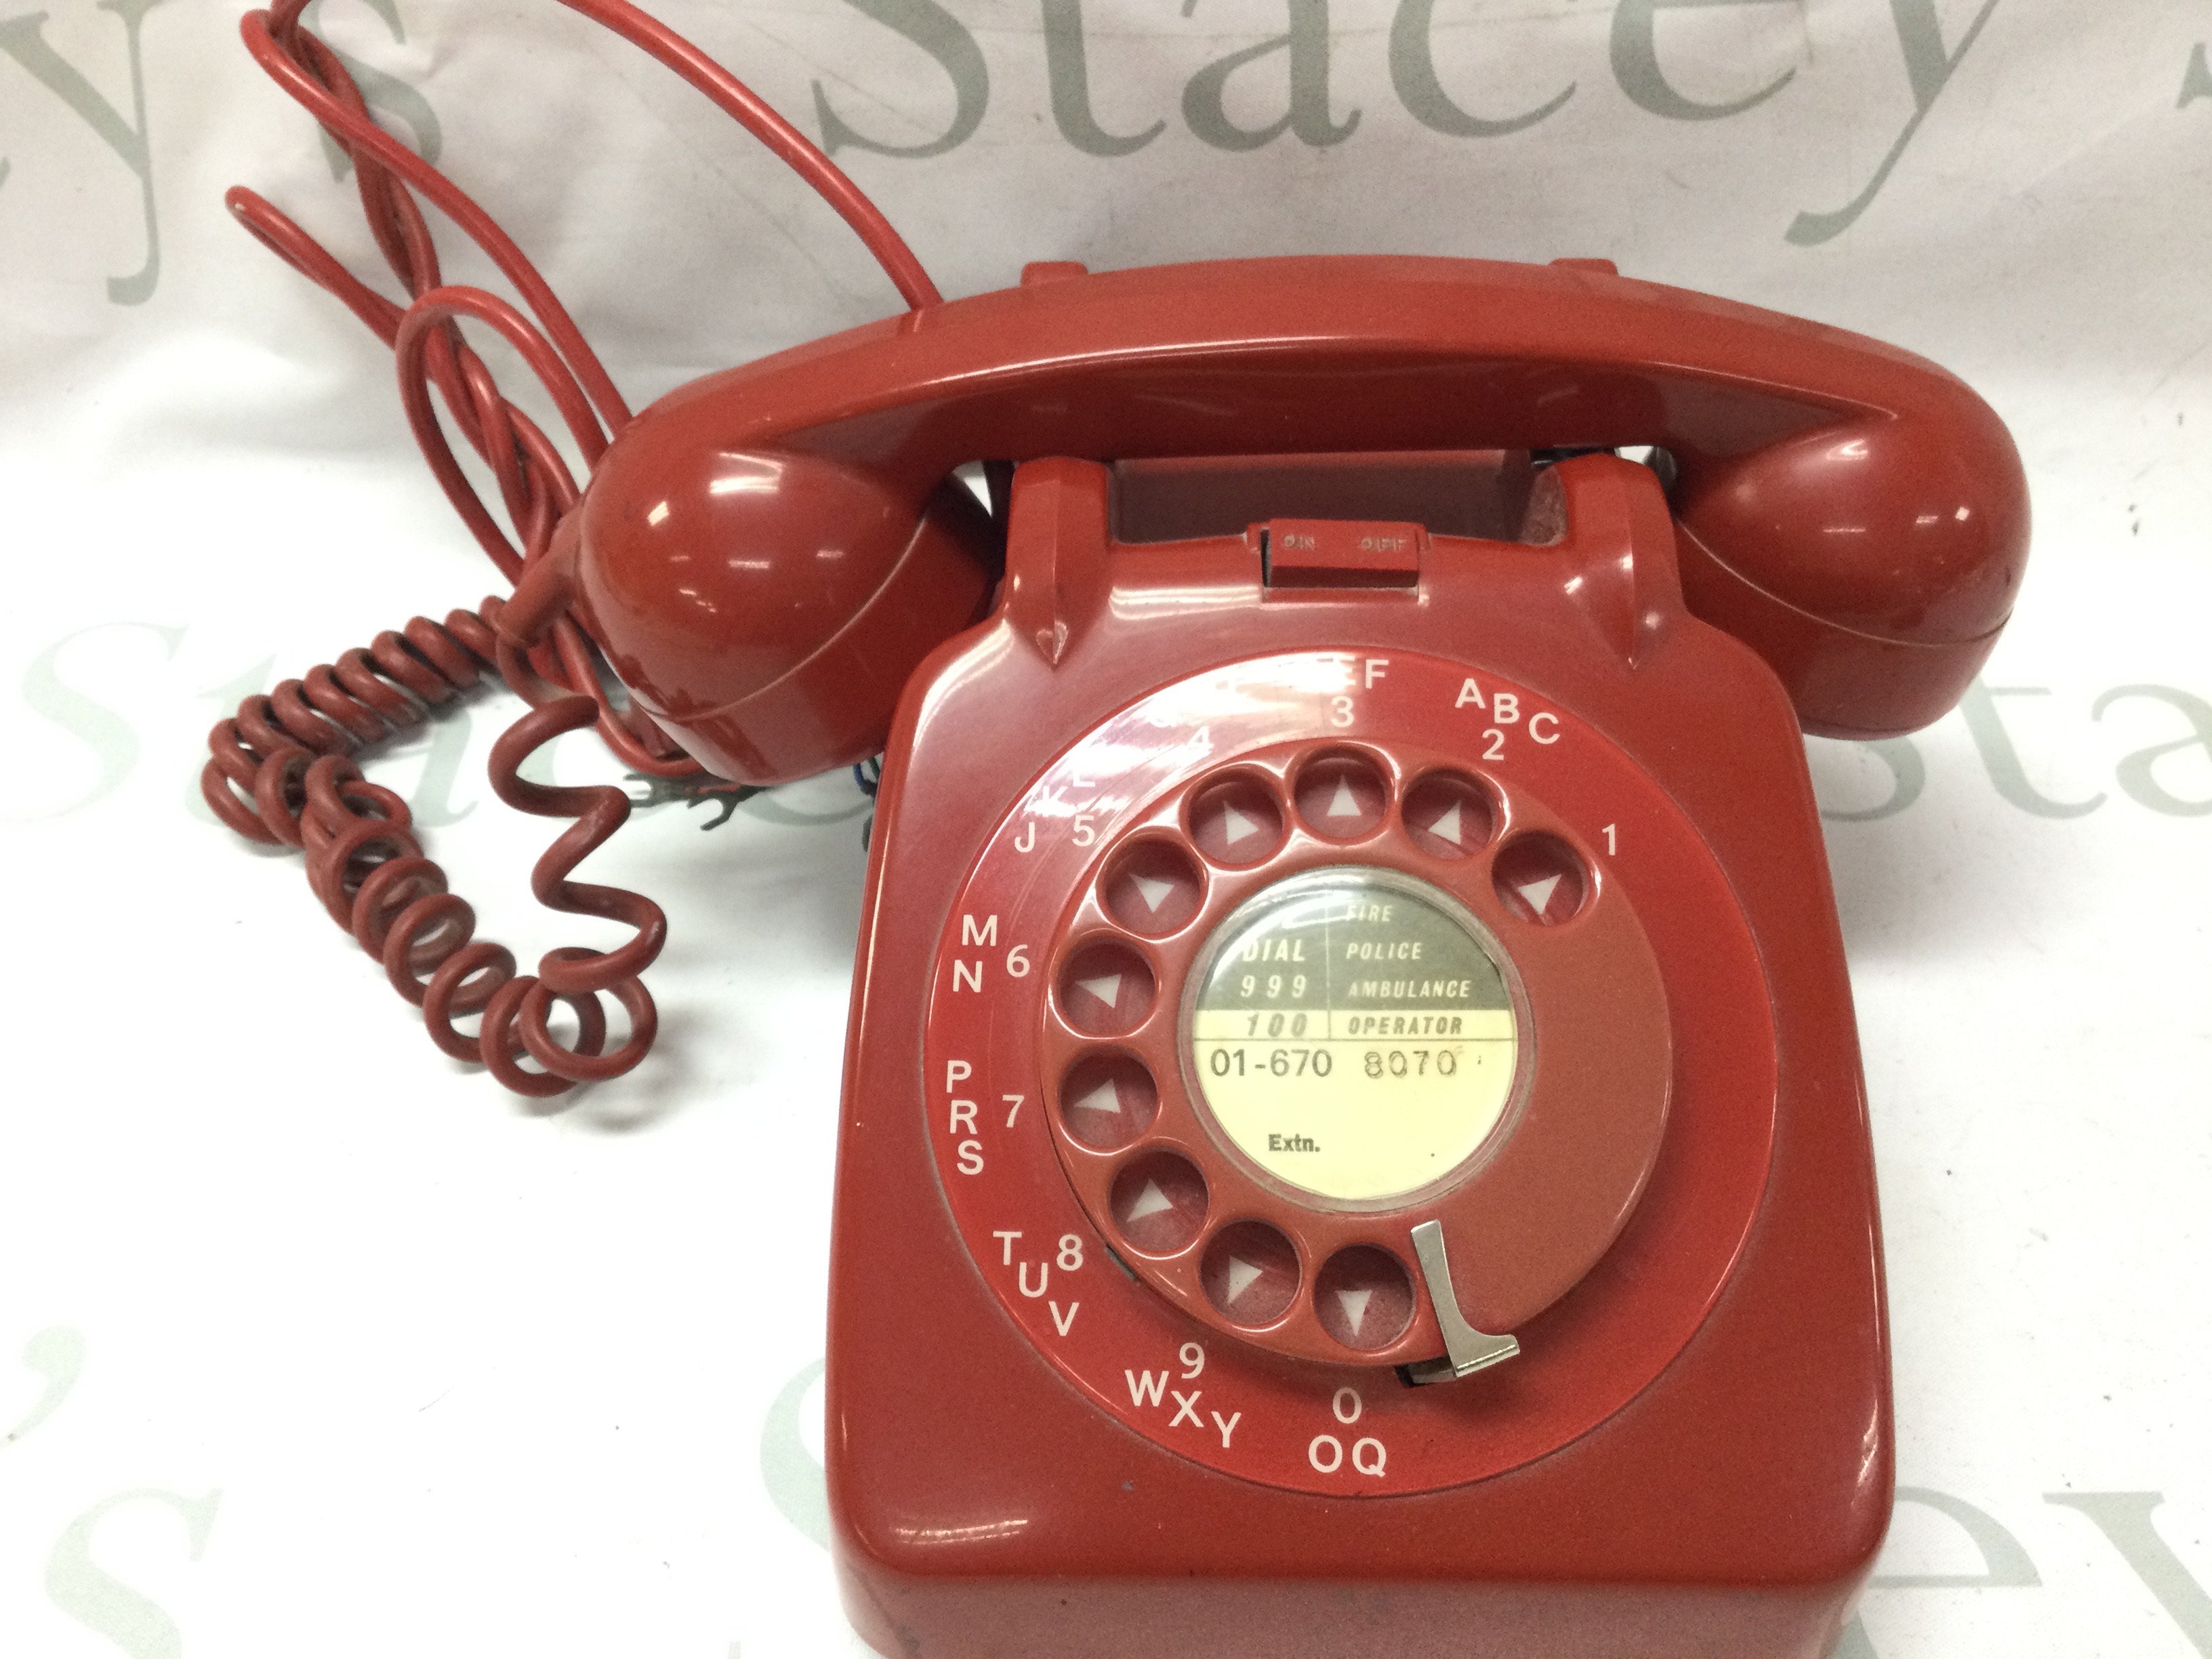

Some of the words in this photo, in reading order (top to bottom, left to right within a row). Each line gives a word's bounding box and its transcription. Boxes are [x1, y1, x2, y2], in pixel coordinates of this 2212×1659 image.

[1330, 695, 1355, 728] 3
[1482, 729, 1504, 760] 2
[1071, 815, 1095, 847] 5
[1602, 823, 1616, 856] 1
[1346, 904, 1393, 922] FIRE
[1006, 944, 1030, 977] 6
[1243, 939, 1306, 962] DIAL
[1346, 941, 1422, 961] POLICE
[1347, 980, 1471, 998] AMBULANCE
[1348, 1017, 1462, 1035] OPERATOR
[1210, 1048, 1332, 1077] 01-670
[1364, 1050, 1458, 1078] 8070
[1002, 1094, 1025, 1128] 7
[1268, 1133, 1321, 1153] Extn.
[1057, 1234, 1083, 1271] 8
[1179, 1343, 1204, 1378] 9
